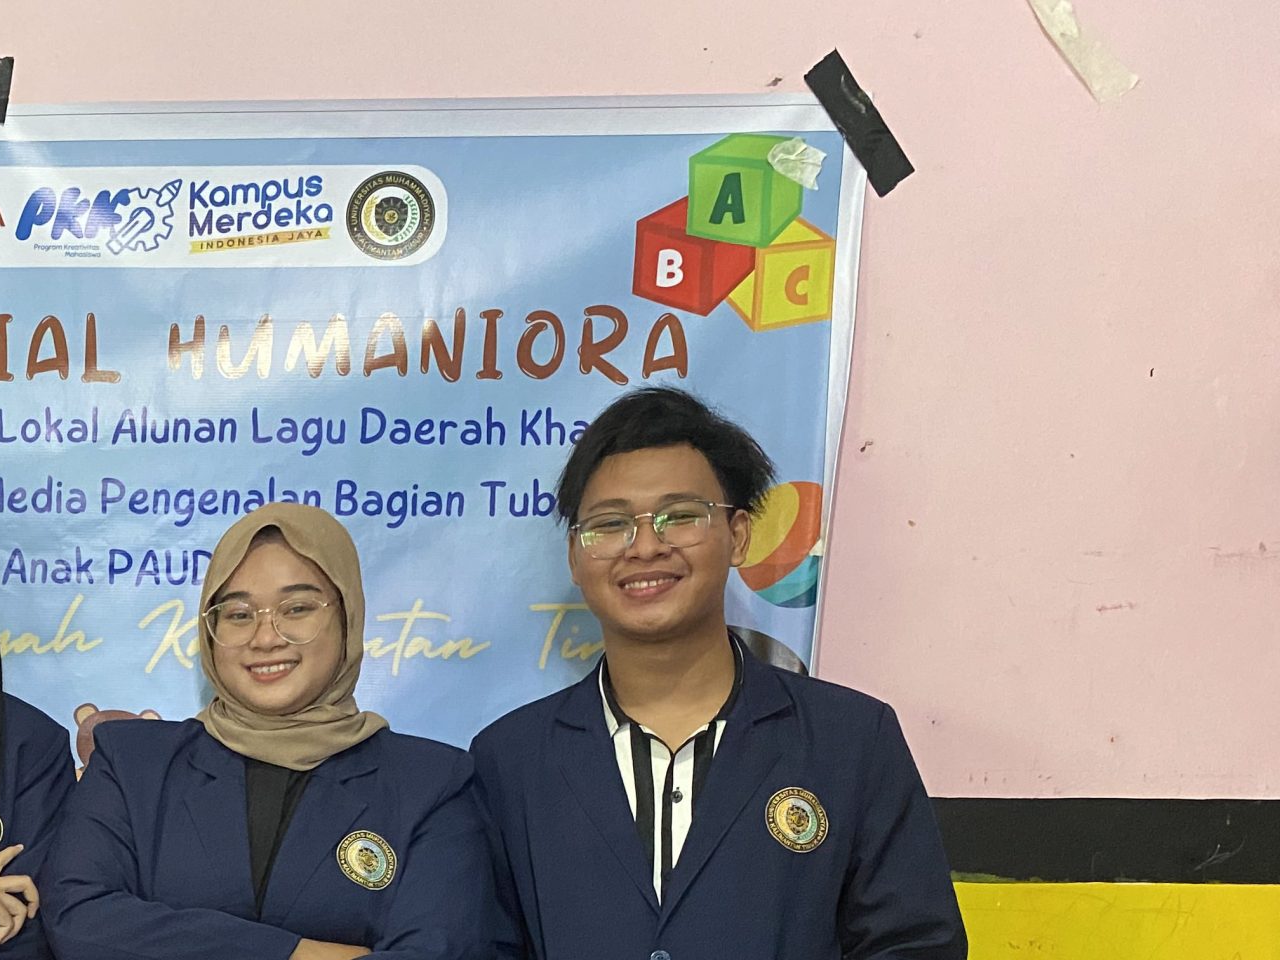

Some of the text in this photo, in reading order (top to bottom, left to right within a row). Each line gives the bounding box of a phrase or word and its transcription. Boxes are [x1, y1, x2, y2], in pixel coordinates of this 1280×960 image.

[189, 175, 323, 210] Kampus
[709, 172, 745, 224] A
[189, 200, 333, 237] Merdeka
[200, 229, 323, 250] INDONESIA JAYA
[656, 248, 684, 287] B
[785, 265, 810, 305] C
[167, 304, 688, 386] HUMANIORA
[112, 406, 237, 444] Alunan
[252, 406, 346, 456] Lagu
[360, 406, 505, 446] Daerah
[521, 407, 589, 446] Kha
[335, 479, 464, 528] Bagian
[480, 478, 557, 517] Tub
[2, 548, 94, 586] Anak
[108, 549, 213, 587] PAUD
